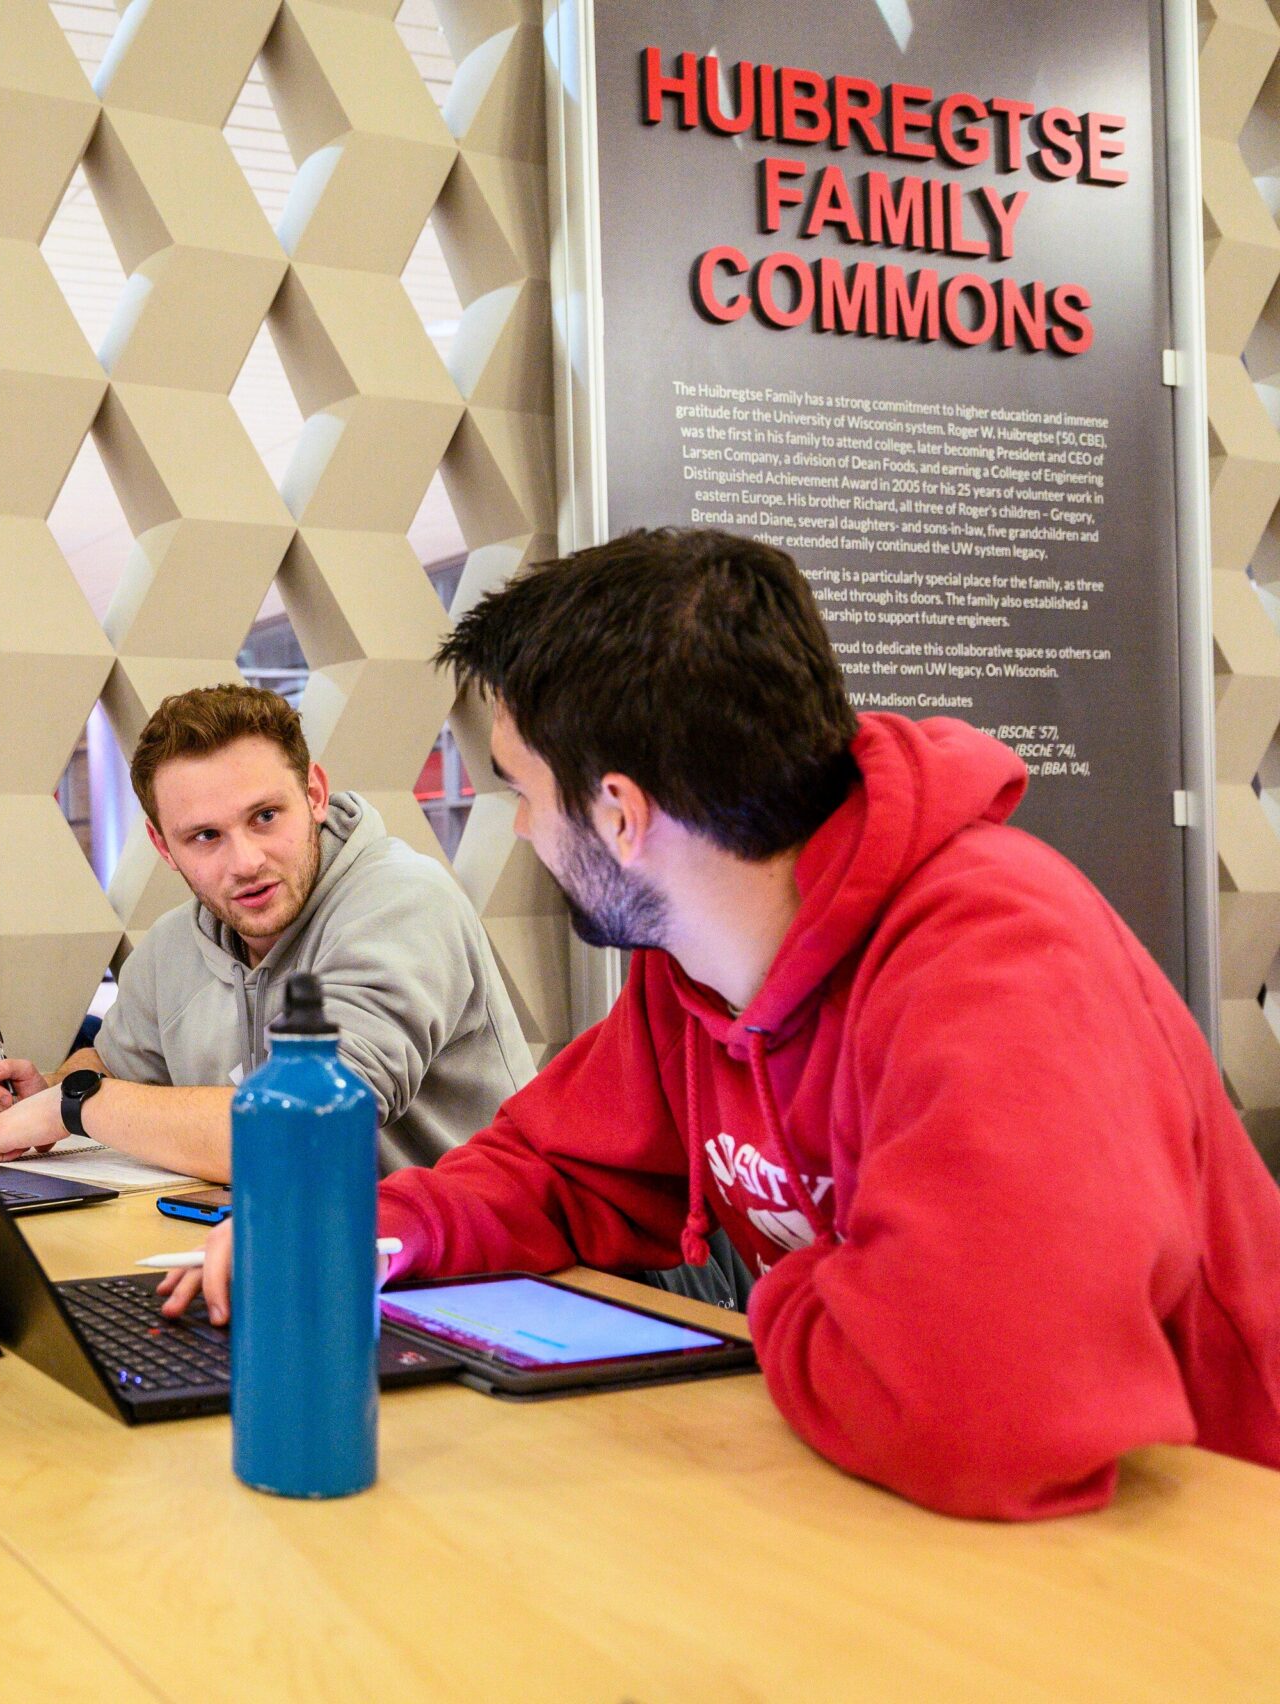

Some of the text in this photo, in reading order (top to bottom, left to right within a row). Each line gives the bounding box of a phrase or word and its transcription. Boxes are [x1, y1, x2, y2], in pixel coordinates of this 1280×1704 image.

[642, 46, 1129, 187] HUIBREGTSE
[760, 157, 1029, 259] FAMILY
[691, 245, 1095, 356] COMMONS
[672, 381, 1108, 428] The Huibregtse Family has a strong commitment to higher education and immense
[675, 405, 730, 419] gratitude
[732, 407, 750, 420] for
[752, 408, 771, 422] the
[773, 411, 831, 427] University
[833, 415, 844, 427] of
[847, 416, 904, 431] Wisconsin
[905, 423, 945, 435] system.
[947, 423, 979, 439] Roger
[979, 426, 996, 438] W.
[997, 428, 1054, 444] Huibregtse
[680, 426, 1104, 465] was the first in his family to attend college, later becoming President and CEO of
[682, 446, 1104, 486] Larsen Company, a division of Dean Foods, and earning a College of Engineering
[683, 466, 1104, 504] Distinguished Achievement Award in 2005 for his 25 years of volunteer work in
[694, 491, 739, 502] eastern
[740, 490, 786, 506] Europe.
[787, 493, 806, 506] His
[807, 495, 852, 508] brother
[853, 496, 897, 512] Richard,
[899, 500, 912, 512] all
[914, 501, 943, 514] three
[945, 503, 956, 514] of
[998, 506, 1041, 519] children
[690, 508, 733, 523] Brenda
[736, 513, 757, 524] and
[759, 512, 796, 526] Diane,
[797, 517, 838, 528] several
[839, 518, 899, 532] daughters-
[901, 521, 921, 533] and
[987, 524, 1007, 537] five
[1008, 528, 1079, 540] grandchildren
[1080, 531, 1098, 542] and
[752, 529, 1047, 560] other extended family continued the UW system legacy.
[798, 568, 1104, 591] neering is a particularly special place for the family, as three
[849, 590, 893, 605] through
[894, 591, 909, 603] its
[910, 592, 943, 604] doors.
[944, 592, 965, 605] The
[966, 594, 999, 608] family
[1000, 596, 1021, 607] also
[1022, 597, 1080, 609] established
[1082, 601, 1088, 610] a
[819, 609, 1010, 628] olarship to support future engineers.
[861, 642, 873, 654] to
[874, 642, 922, 654] dedicate
[923, 643, 943, 655] this
[944, 644, 1013, 657] collaborative
[1013, 648, 1043, 658] space
[1044, 649, 1057, 658] so
[1058, 648, 1091, 659] others
[1092, 650, 1110, 659] can
[838, 662, 1059, 678] reate their own UW legacy. On Wisconsin.
[917, 694, 973, 707] Graduates
